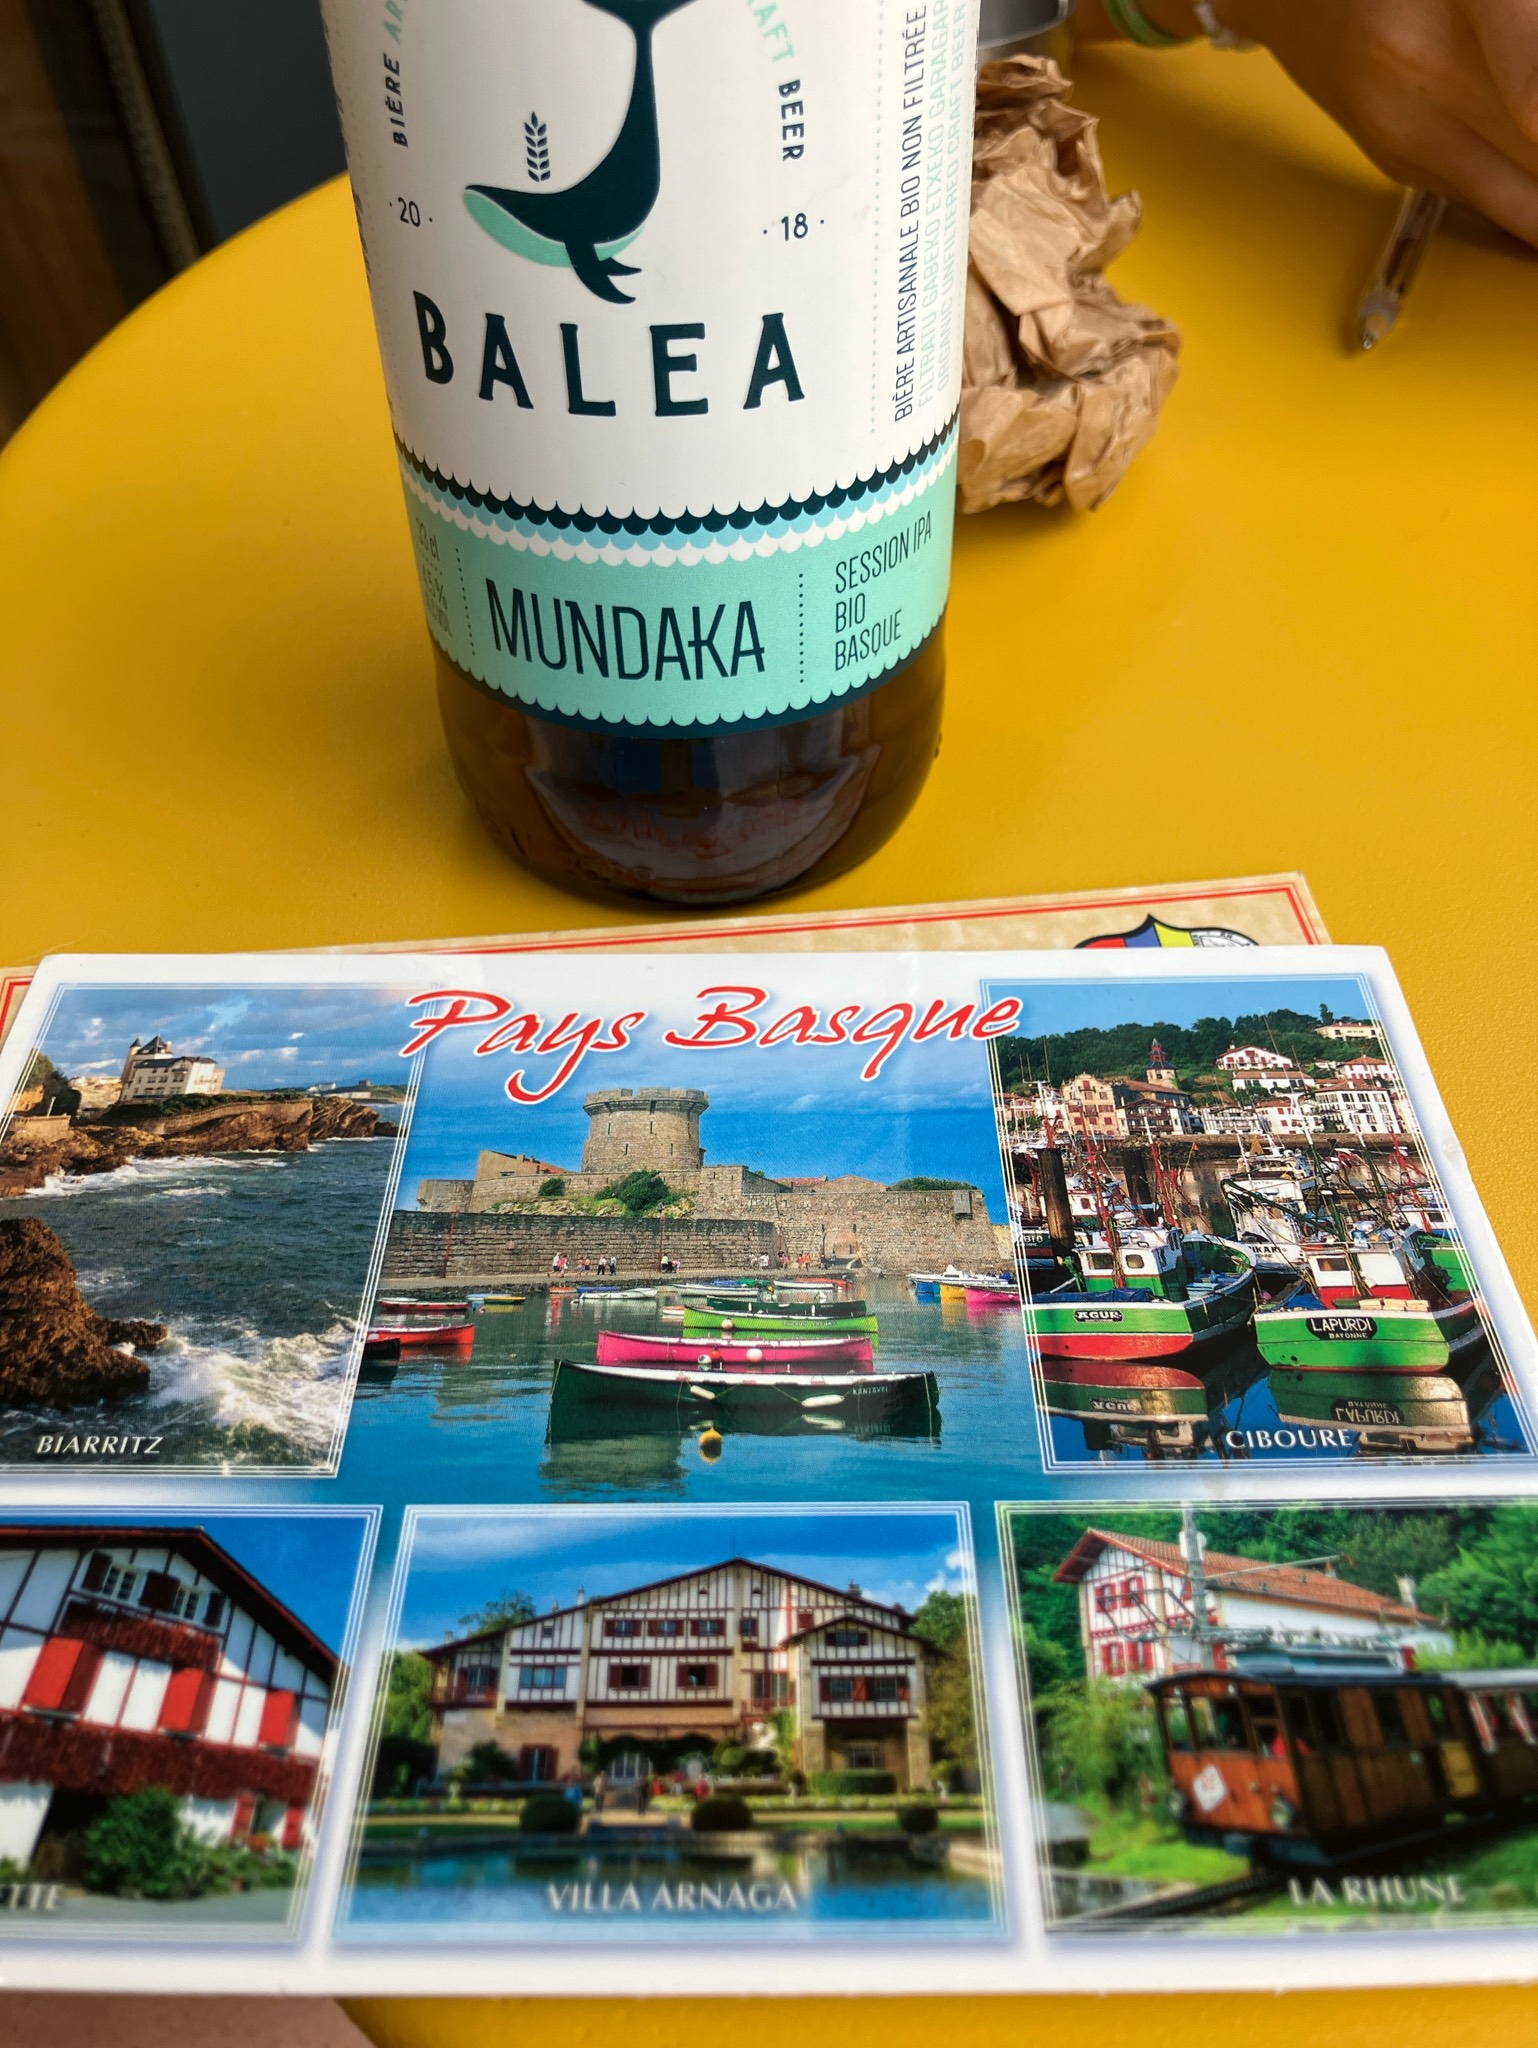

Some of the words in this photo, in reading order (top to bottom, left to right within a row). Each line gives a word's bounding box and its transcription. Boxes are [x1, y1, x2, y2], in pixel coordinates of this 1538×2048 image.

[902, 5, 926, 110] FILTRÉE
[384, 52, 408, 148] BIÈRE
[778, 78, 805, 162] BEER
[901, 114, 922, 171] NON
[398, 196, 422, 228] 20
[901, 175, 920, 218] BIO
[780, 211, 809, 241] 18
[897, 220, 919, 356] ARTISANALE
[413, 290, 805, 418] BALEA
[892, 357, 914, 422] BIÈRE
[835, 526, 910, 594] SESSION
[913, 510, 932, 554] IPA
[485, 577, 766, 683] MUNDAKA
[835, 592, 866, 634] BIO
[835, 609, 903, 672] BASQUE
[398, 987, 648, 1106] Pays
[663, 983, 1026, 1082] Basque
[1310, 1317, 1373, 1332] LAPURDI
[36, 1435, 165, 1455] BIARRITZ
[1225, 1428, 1353, 1450] CIBOURE
[0, 1882, 64, 1912] TTE
[548, 1880, 641, 1914] VILLA
[651, 1880, 798, 1913] ARNAGA
[1287, 1875, 1335, 1906] LA
[1340, 1874, 1467, 1905] RHUNE
